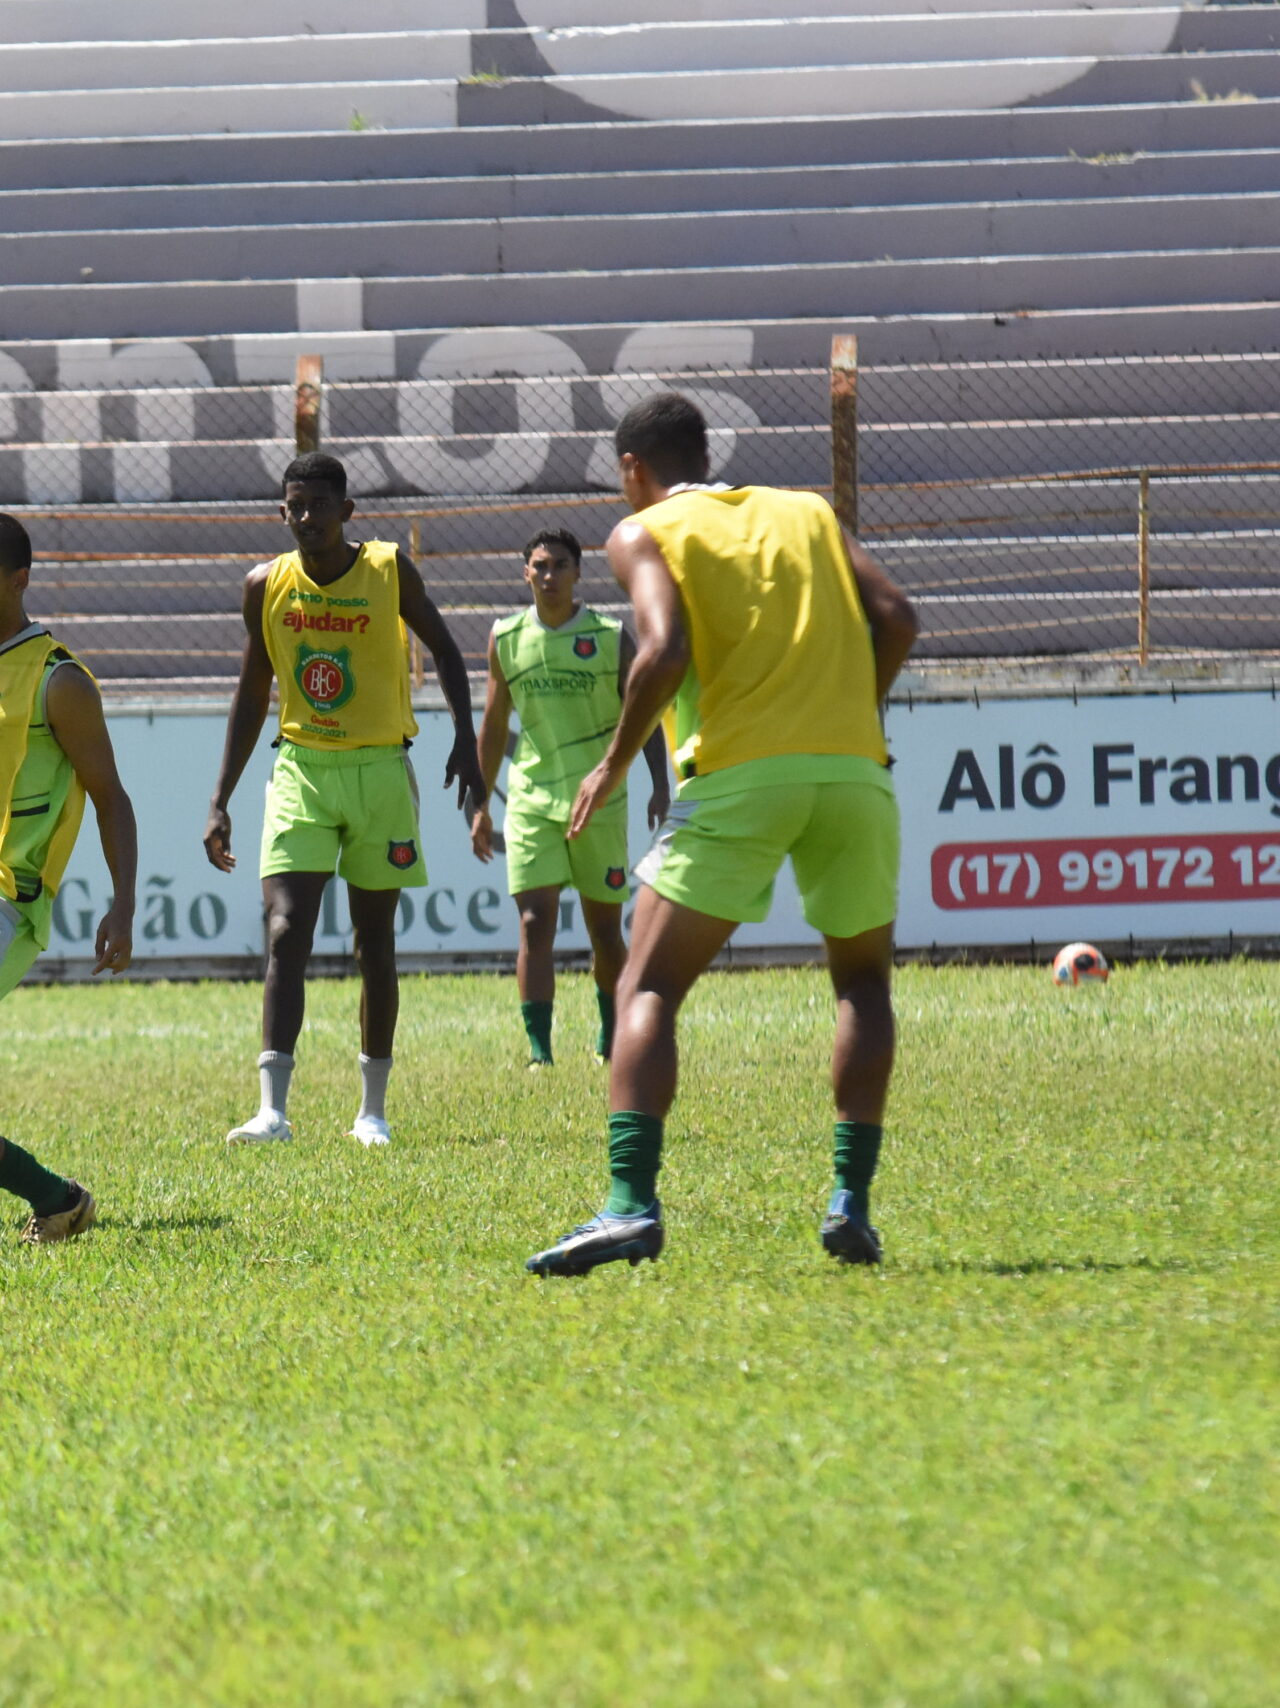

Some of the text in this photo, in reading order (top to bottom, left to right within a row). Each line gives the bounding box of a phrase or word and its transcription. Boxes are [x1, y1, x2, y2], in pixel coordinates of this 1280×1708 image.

[288, 588, 369, 607] Como posso
[283, 609, 370, 634] ajudar?
[937, 743, 1066, 813] Alô
[948, 853, 1042, 901] (17)
[1058, 847, 1215, 892] 99172
